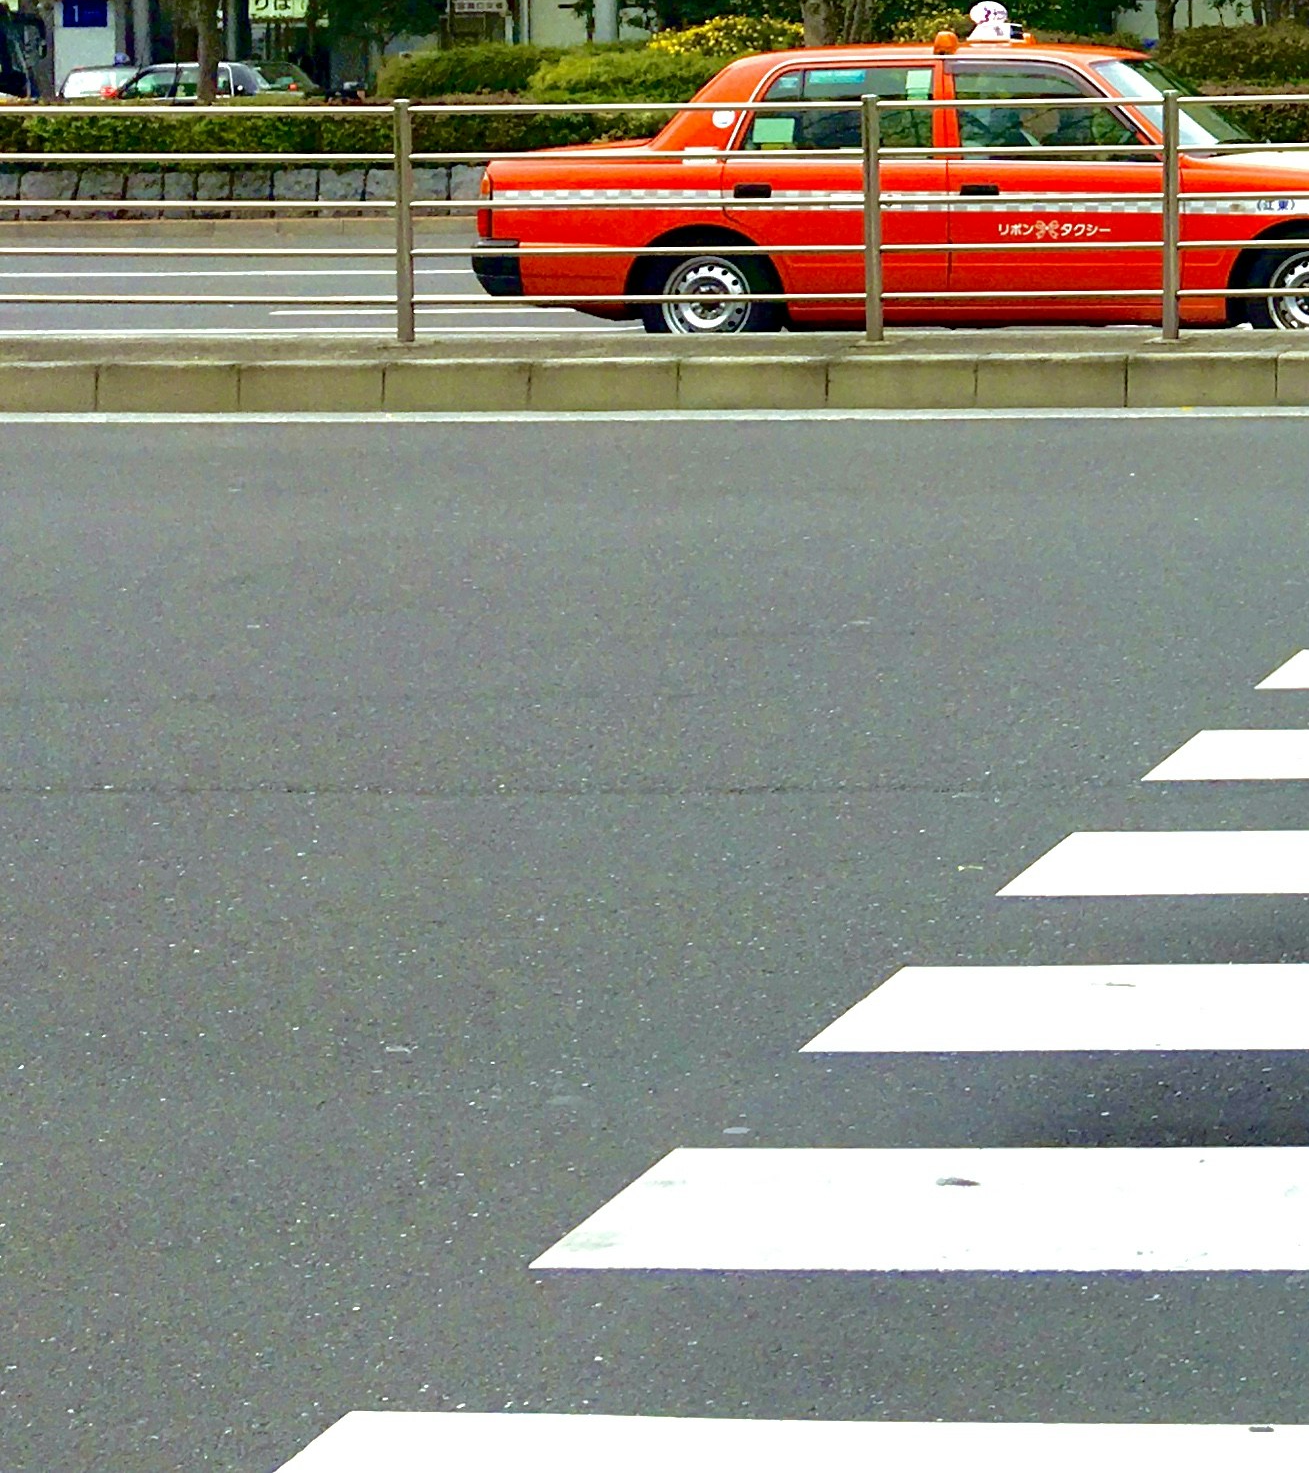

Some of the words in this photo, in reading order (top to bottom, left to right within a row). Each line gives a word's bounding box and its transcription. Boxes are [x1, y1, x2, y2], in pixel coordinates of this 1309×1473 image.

[998, 223, 1034, 237] リボン
[1060, 223, 1111, 237] タクシー
